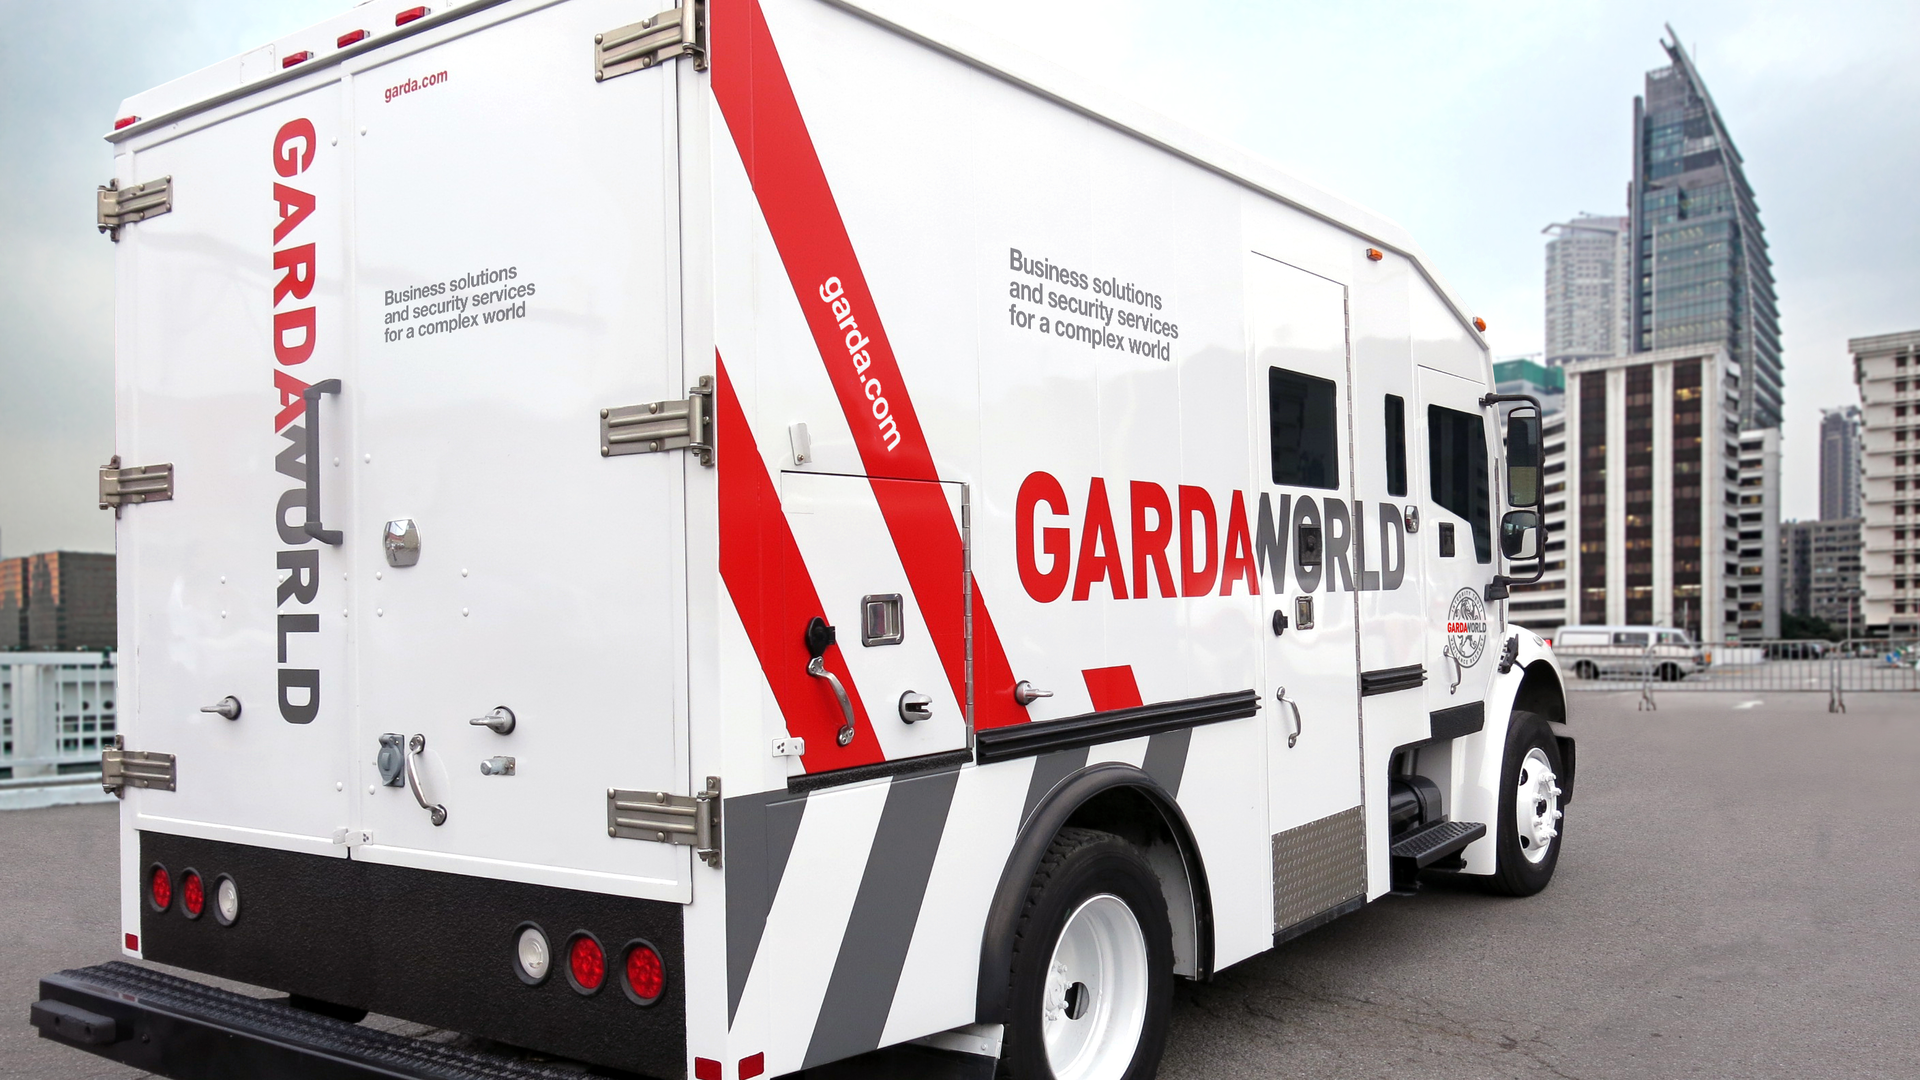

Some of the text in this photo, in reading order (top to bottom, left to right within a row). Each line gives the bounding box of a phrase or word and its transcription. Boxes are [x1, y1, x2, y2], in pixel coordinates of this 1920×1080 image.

[384, 70, 448, 104] garda.com
[384, 266, 518, 306] Business solutions
[384, 282, 536, 325] and security services
[1010, 247, 1163, 311] Business solutions
[384, 300, 526, 343] for a complex world
[1008, 303, 1170, 362] for a complex world
[1009, 281, 1179, 340] and security services
[818, 275, 903, 453] garda.com
[272, 117, 320, 726] GARDAWORLD
[1015, 470, 1406, 604] GARDAWORLD
[1447, 622, 1487, 633] GARDAWORLD
